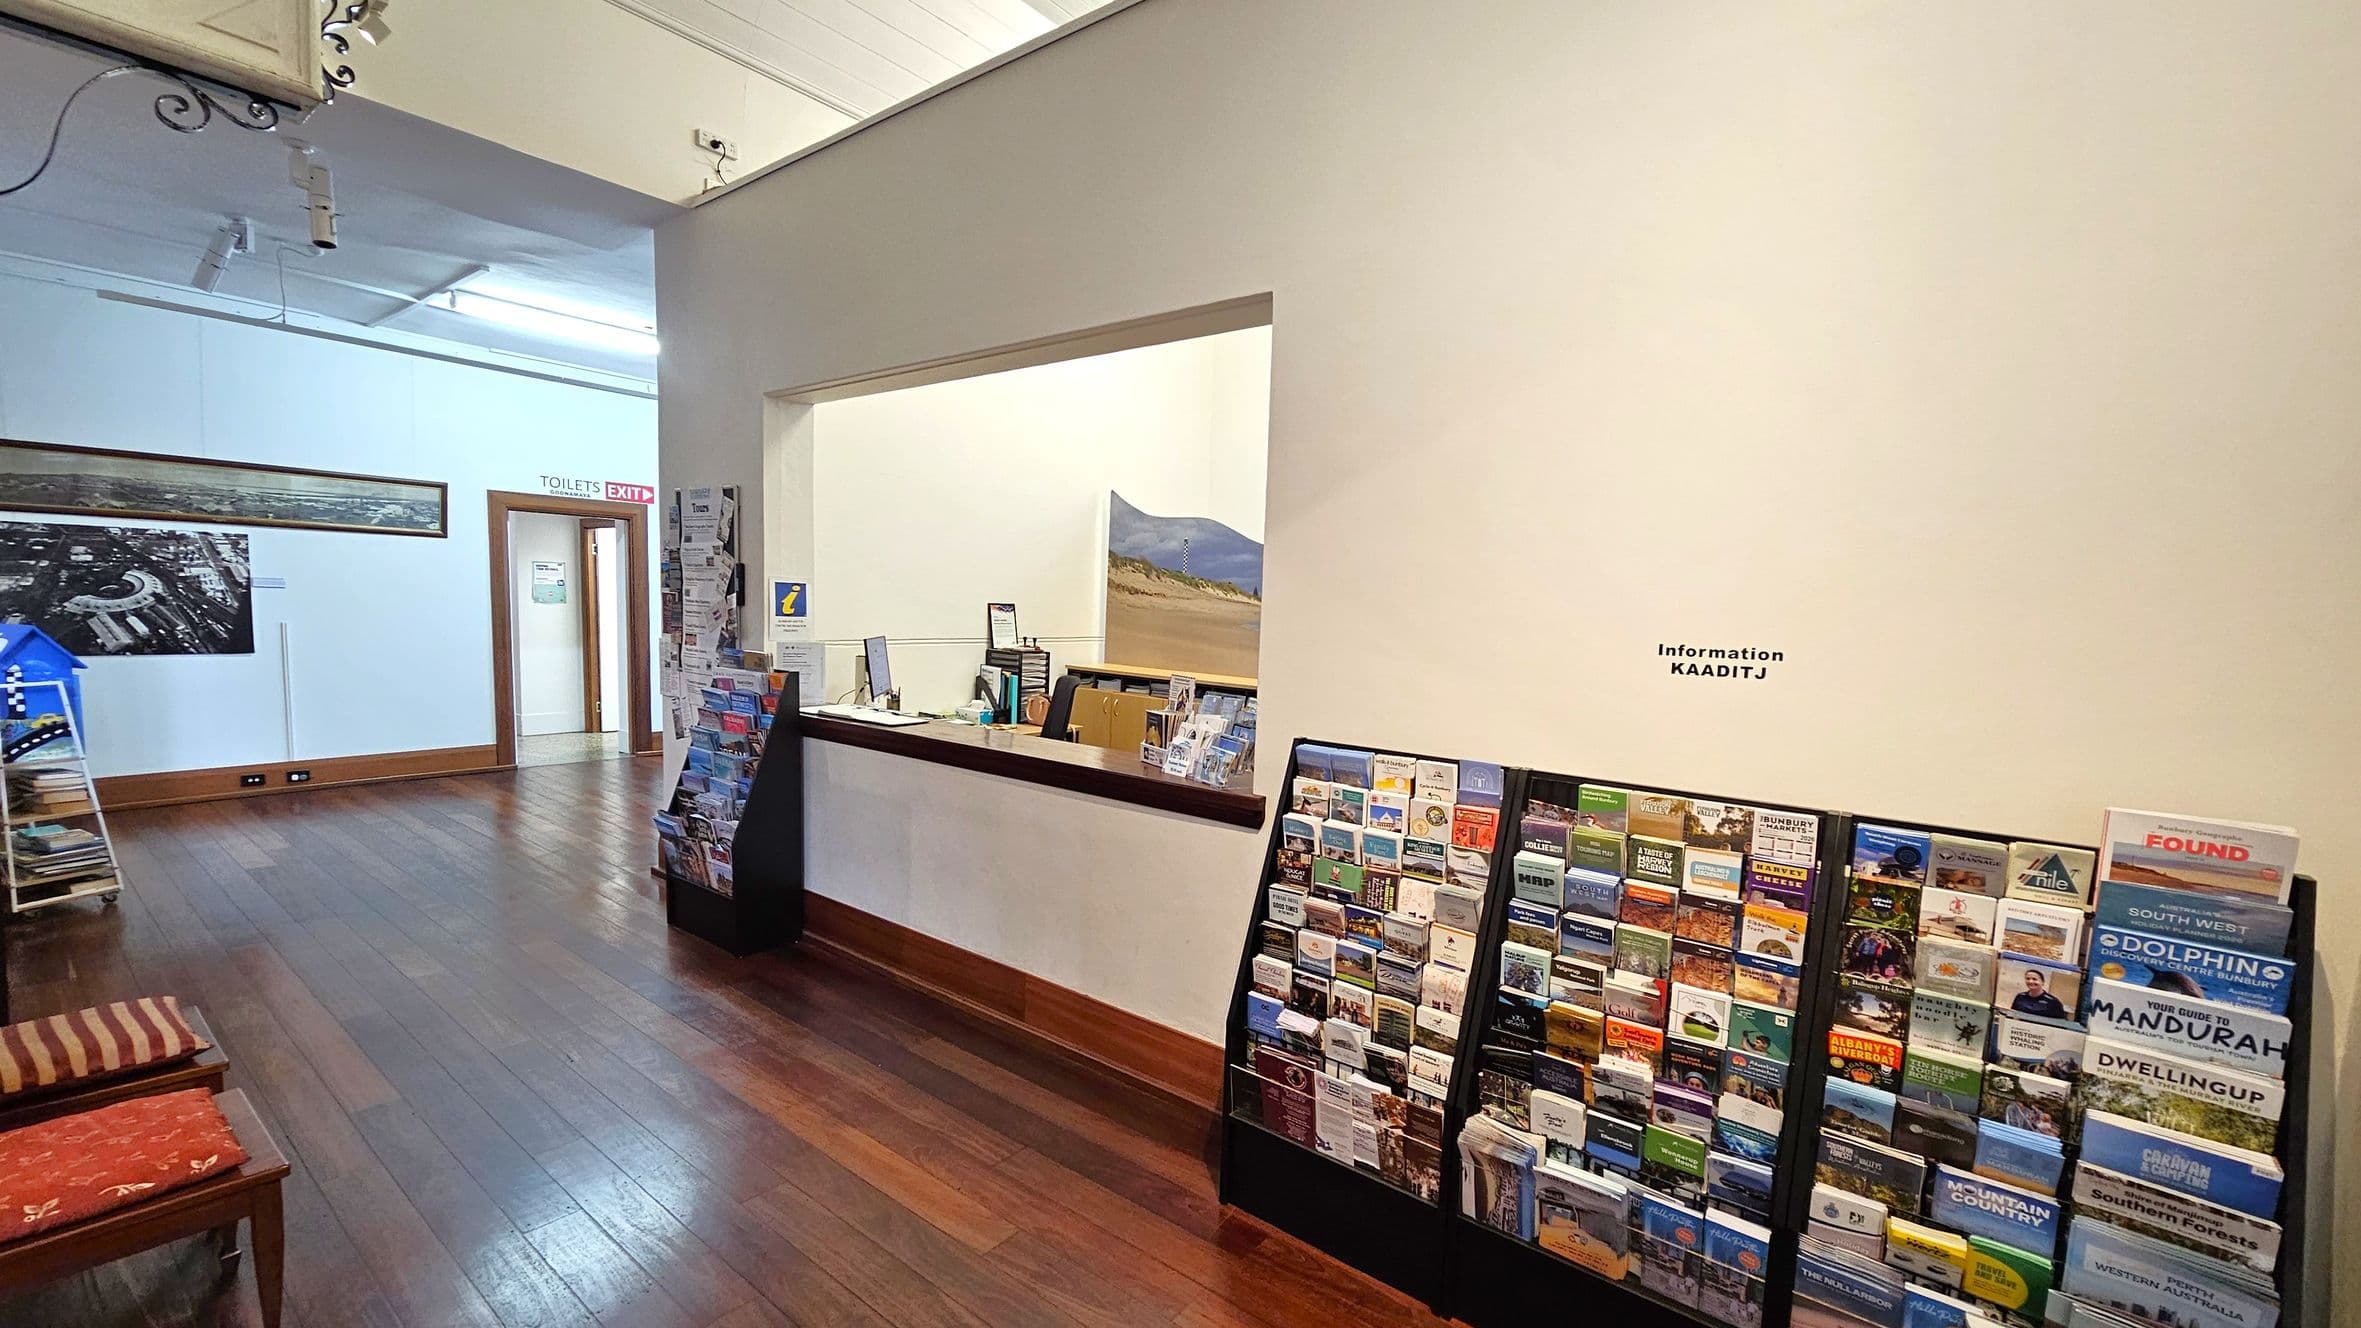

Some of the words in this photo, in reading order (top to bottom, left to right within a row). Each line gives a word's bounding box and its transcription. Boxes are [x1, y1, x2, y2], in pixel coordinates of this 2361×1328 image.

[540, 475, 600, 493] TOILETS
[607, 484, 641, 500] EXIT
[1658, 643, 1784, 662] Information
[1671, 662, 1767, 680] KAADITJ
[1640, 804, 1670, 816] VALLEY
[1764, 816, 1814, 828] BUNBURY
[1766, 824, 1807, 834] MARKETS
[2158, 824, 2193, 836] Bunbury
[1524, 841, 1549, 851] COLLIE
[1644, 848, 1663, 857] TASTE
[2145, 833, 2250, 862] FOUND
[1637, 861, 1672, 875] REGION
[1638, 855, 1673, 867] HARVEY
[1756, 863, 1804, 877] HARVEY
[1518, 873, 1555, 887] MAP
[1575, 883, 1609, 896] SOUTH
[1755, 875, 1803, 888] CHEESE
[2036, 870, 2069, 890] nile
[1570, 889, 1595, 898] WEST
[2158, 903, 2221, 918] AUSTRALIA'S
[2128, 907, 2190, 926] SOUTH
[2195, 918, 2250, 936] WEST
[2130, 920, 2171, 932] HOLIDAY
[2121, 935, 2259, 977] DOLPHIN
[2101, 947, 2164, 967] DISCOVERY
[2167, 960, 2213, 977] CENTRE
[2217, 970, 2278, 990] BUNBURY
[1608, 1003, 1635, 1018] Golf
[1917, 996, 1977, 1015] naughty
[2147, 1000, 2175, 1015] YOUR
[2178, 1007, 2213, 1024] GUIDE
[2215, 1016, 2230, 1026] TO
[1915, 1012, 1939, 1023] bar
[2089, 998, 2289, 1060] MANDURAH
[2114, 1026, 2164, 1040] AUSTRALIA'S
[2167, 1036, 2184, 1045] TOP
[1831, 1036, 1896, 1057] ALBANY'S
[2009, 1040, 2041, 1051] STATION
[2010, 1036, 2046, 1047] WHALING
[1831, 1045, 1896, 1066] RIVERBOAT
[1908, 1071, 1946, 1085] ROUTE
[1910, 1058, 1930, 1069] TIN
[1931, 1063, 1968, 1079] HORSE
[2098, 1053, 2266, 1104] DWELLINGUP
[2097, 1067, 2145, 1083] PINJARRA
[2157, 1081, 2177, 1091] THE
[2180, 1088, 2224, 1104] MURRAY
[2226, 1100, 2262, 1114] RIVER
[1661, 1146, 1699, 1165] Wonnerup
[1675, 1157, 1698, 1170] House
[1859, 1157, 1882, 1171] VALLEYS
[2142, 1148, 2212, 1179] CARAVAN
[2150, 1163, 2209, 1190] CAMPING
[1947, 1179, 2051, 1220] MOUNTAIN
[2123, 1190, 2152, 1203] Shire
[2153, 1199, 2166, 1207] of
[2167, 1203, 2224, 1228] Manjimup
[1950, 1191, 2045, 1228] COUNTRY
[2091, 1188, 2179, 1225] Southern
[2182, 1213, 2259, 1250] Forests
[1906, 1237, 1950, 1258] Hertz
[1974, 1270, 1994, 1281] AND
[1995, 1275, 2017, 1289] SAVE
[1976, 1262, 2007, 1278] TRAVEL
[1801, 1267, 1824, 1282] THE
[1823, 1276, 1894, 1310] NULLARBOR
[2095, 1261, 2160, 1290] WESTERN
[2163, 1285, 2245, 1322] AUSTRALIA
[2167, 1276, 2216, 1302] PERTH
